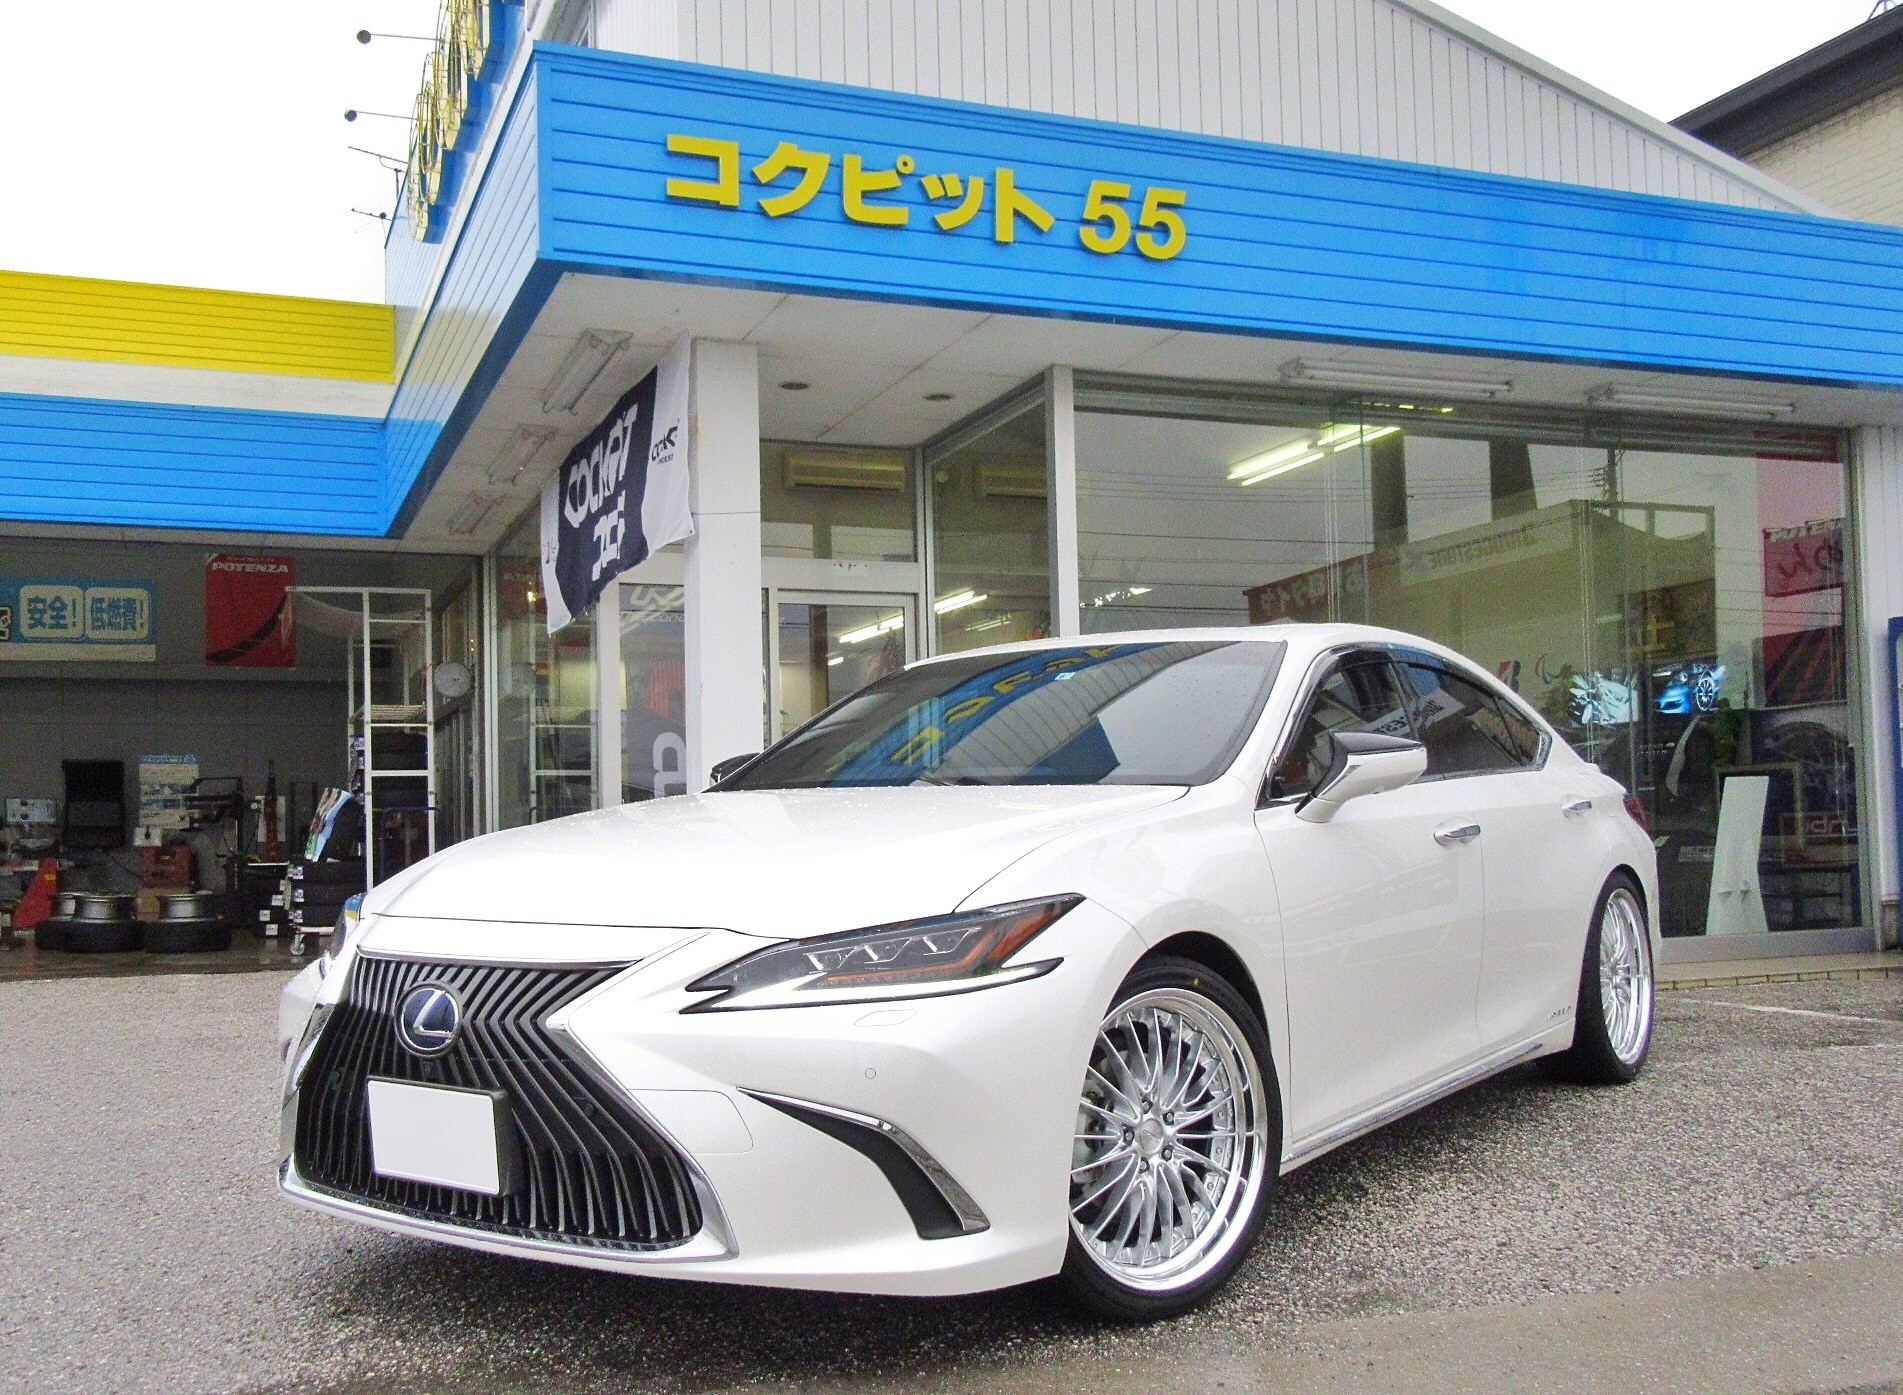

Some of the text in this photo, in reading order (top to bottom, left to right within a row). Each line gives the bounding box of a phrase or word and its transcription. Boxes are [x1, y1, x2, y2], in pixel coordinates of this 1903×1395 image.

[667, 134, 1187, 260] コクピット 55
[565, 403, 638, 528] COCKPT
[212, 562, 288, 573] POTENZA
